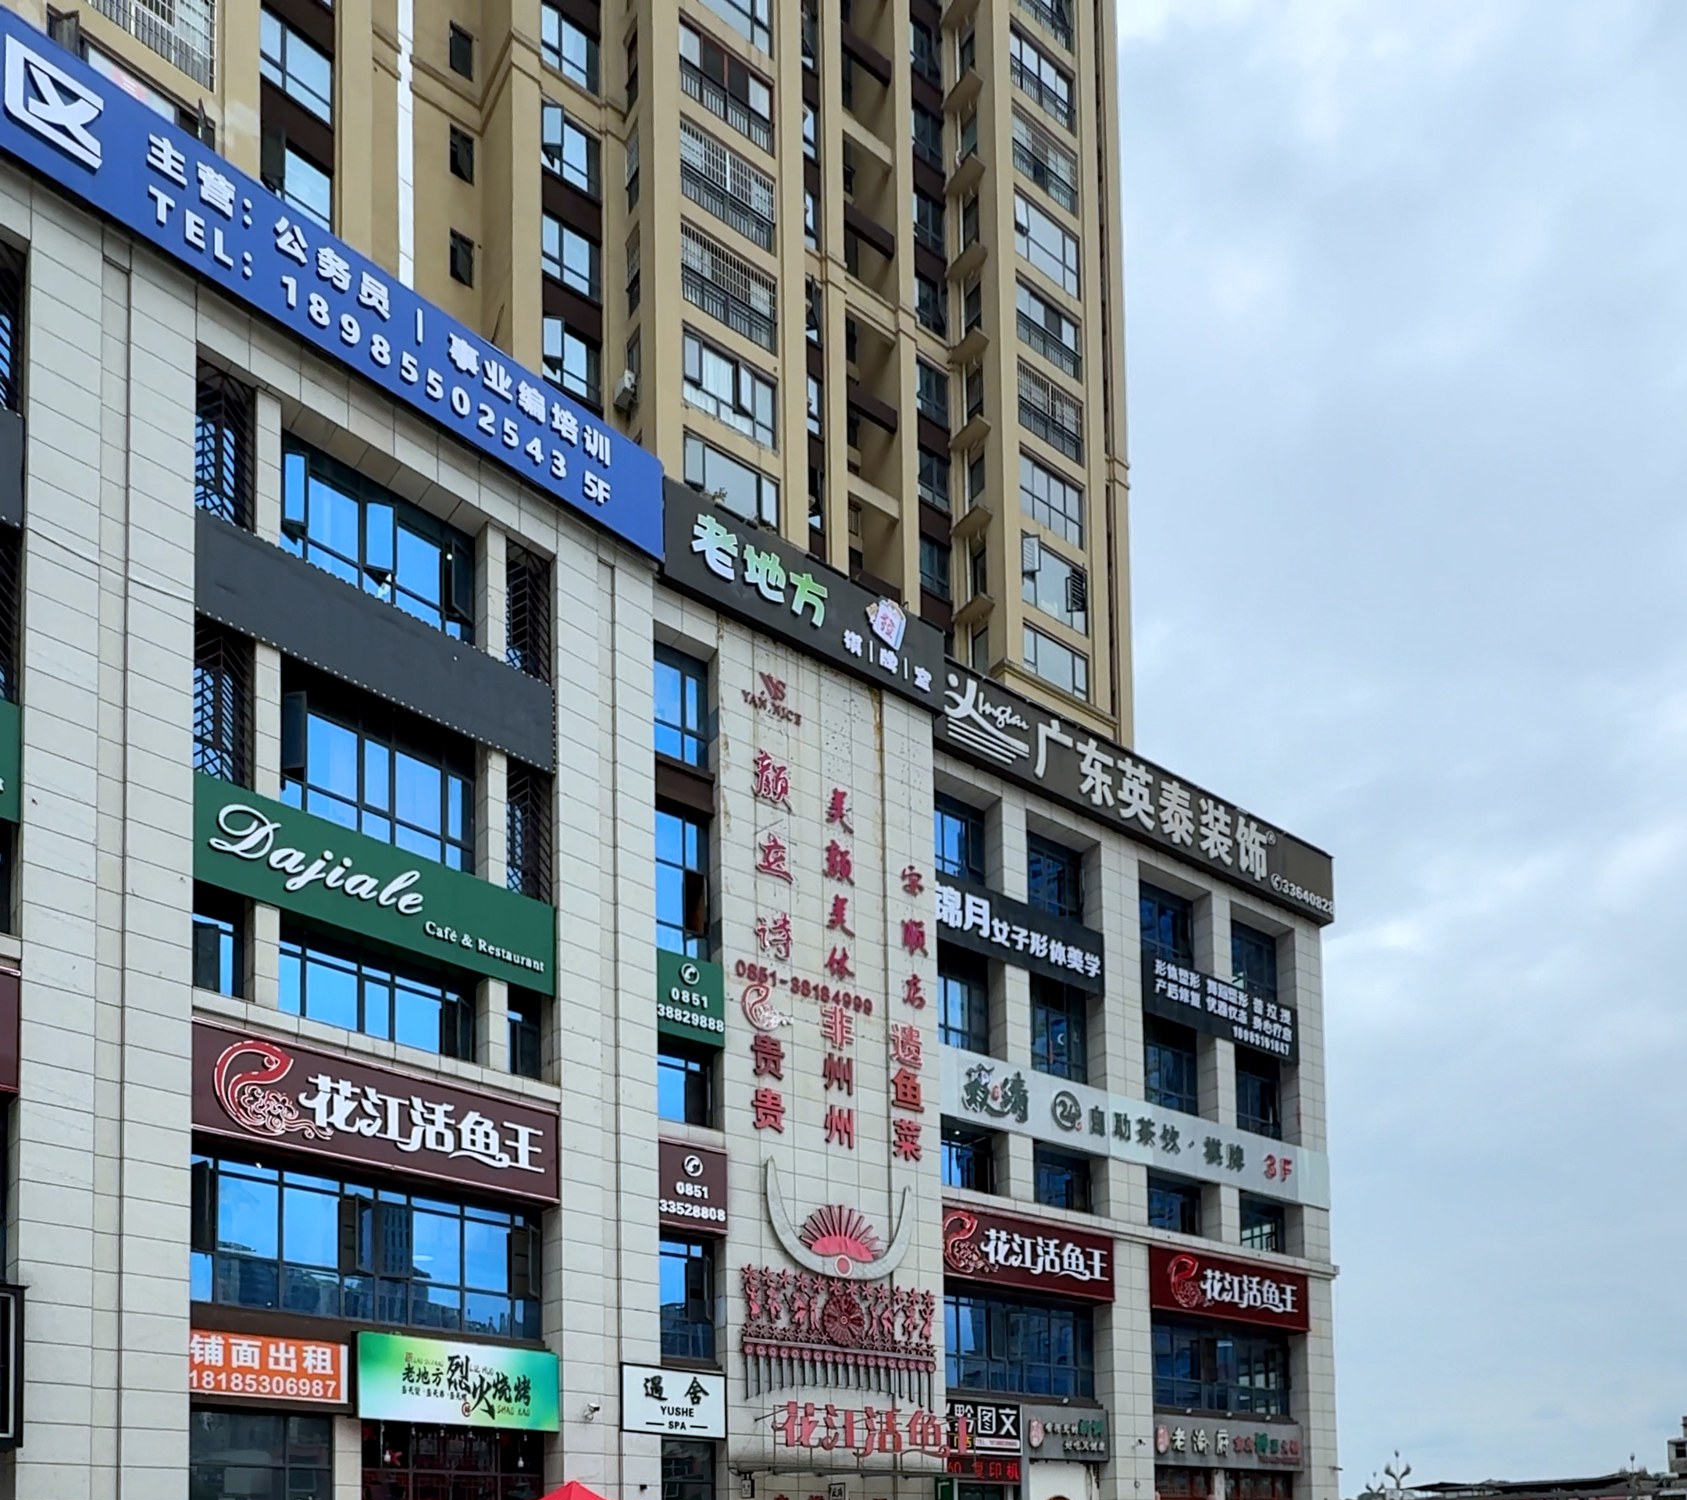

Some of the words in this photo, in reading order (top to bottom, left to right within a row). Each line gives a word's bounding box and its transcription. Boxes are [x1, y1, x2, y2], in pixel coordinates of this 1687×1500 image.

[273, 216, 393, 320] 公务员
[447, 331, 613, 468] 事业编培训
[280, 274, 569, 480] 18985502543
[583, 475, 612, 505] 5F
[691, 513, 829, 628] 老地方
[1033, 718, 1269, 882] 广东英泰装饰
[209, 804, 424, 916] Dajiale
[424, 920, 459, 944] Café
[461, 933, 474, 948] &
[477, 938, 546, 974] Restaurant
[671, 987, 709, 1010] 0851
[657, 1003, 725, 1034] 38829888
[299, 1073, 546, 1173] 花江活鱼王
[1263, 1153, 1293, 1182] 3F
[675, 1180, 709, 1200] 0851
[659, 1199, 726, 1223] 33528808
[980, 1228, 1110, 1282] 花江活鱼王
[1200, 1268, 1300, 1313] 花江活鱼王
[190, 1334, 335, 1376] 铺面出租
[188, 1369, 337, 1399] 18185306987
[401, 1363, 445, 1388] 老地方
[643, 1375, 710, 1406] 遇舍
[660, 1405, 695, 1418] YUSHE
[668, 1420, 687, 1431] SPA
[973, 1461, 1021, 1481] 复印机
